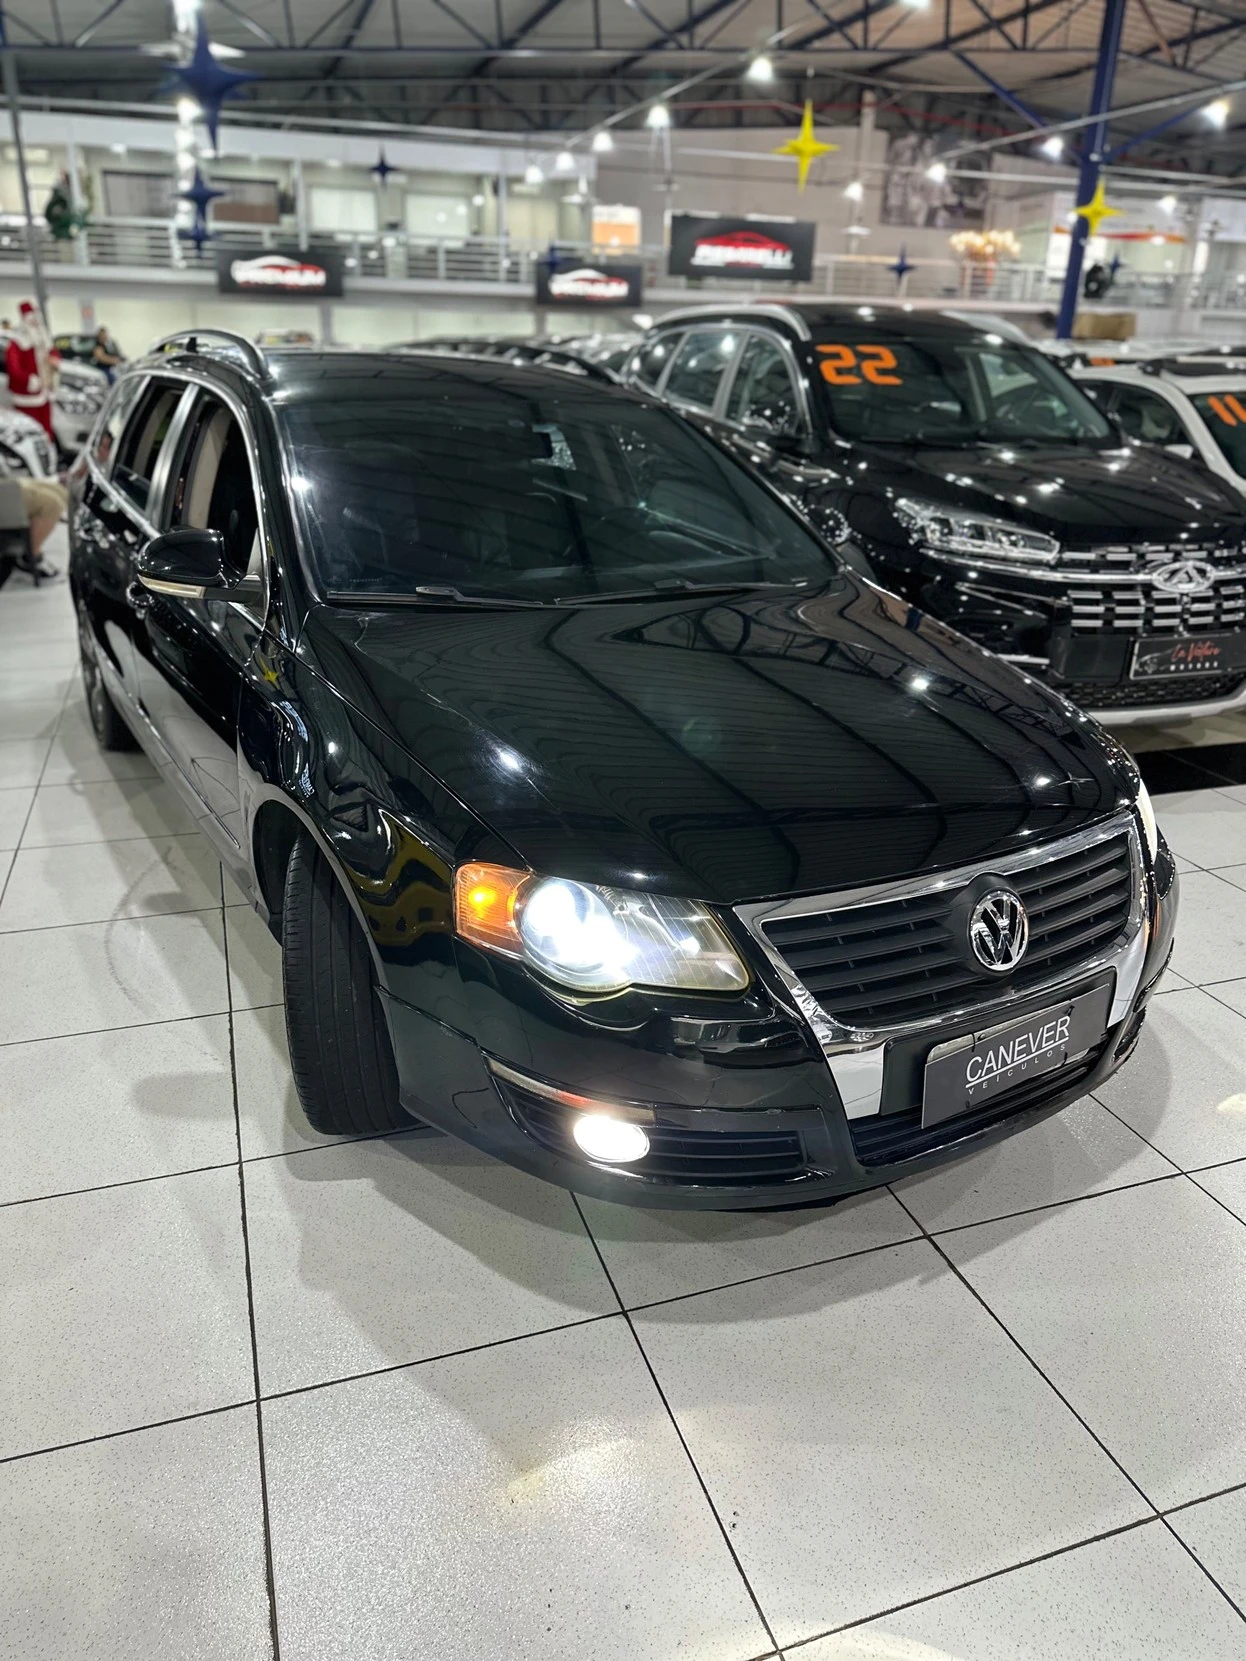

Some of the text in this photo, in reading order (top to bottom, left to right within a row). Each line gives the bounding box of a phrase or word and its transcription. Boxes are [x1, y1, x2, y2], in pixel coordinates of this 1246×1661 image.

[815, 344, 903, 386] 22
[966, 1015, 1071, 1082] CANEVER
[968, 1043, 1066, 1095] VEICULOS
